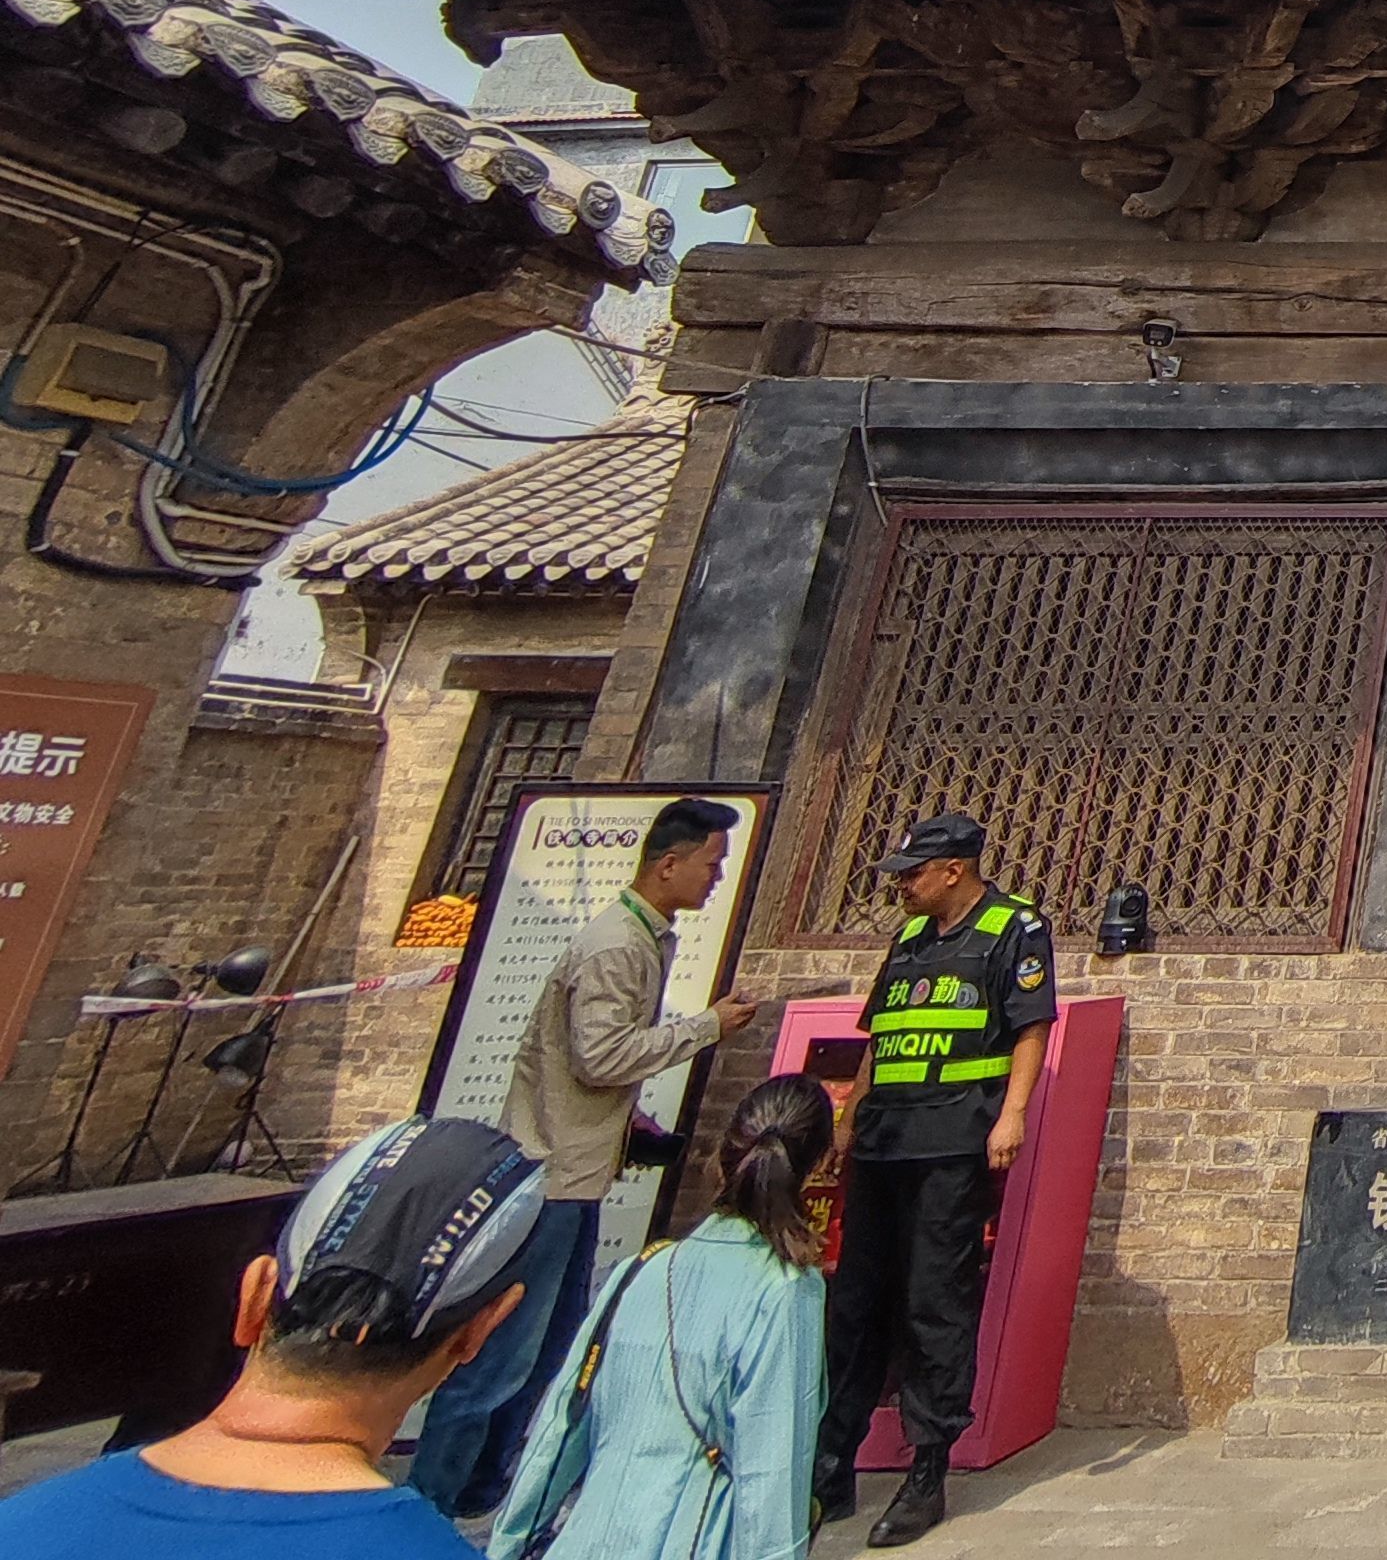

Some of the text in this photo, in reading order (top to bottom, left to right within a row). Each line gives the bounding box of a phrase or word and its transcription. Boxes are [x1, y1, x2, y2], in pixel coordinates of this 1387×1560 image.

[886, 976, 961, 1008] 执勤
[875, 1033, 953, 1058] ZHIQIN
[420, 1187, 494, 1266] WILD
